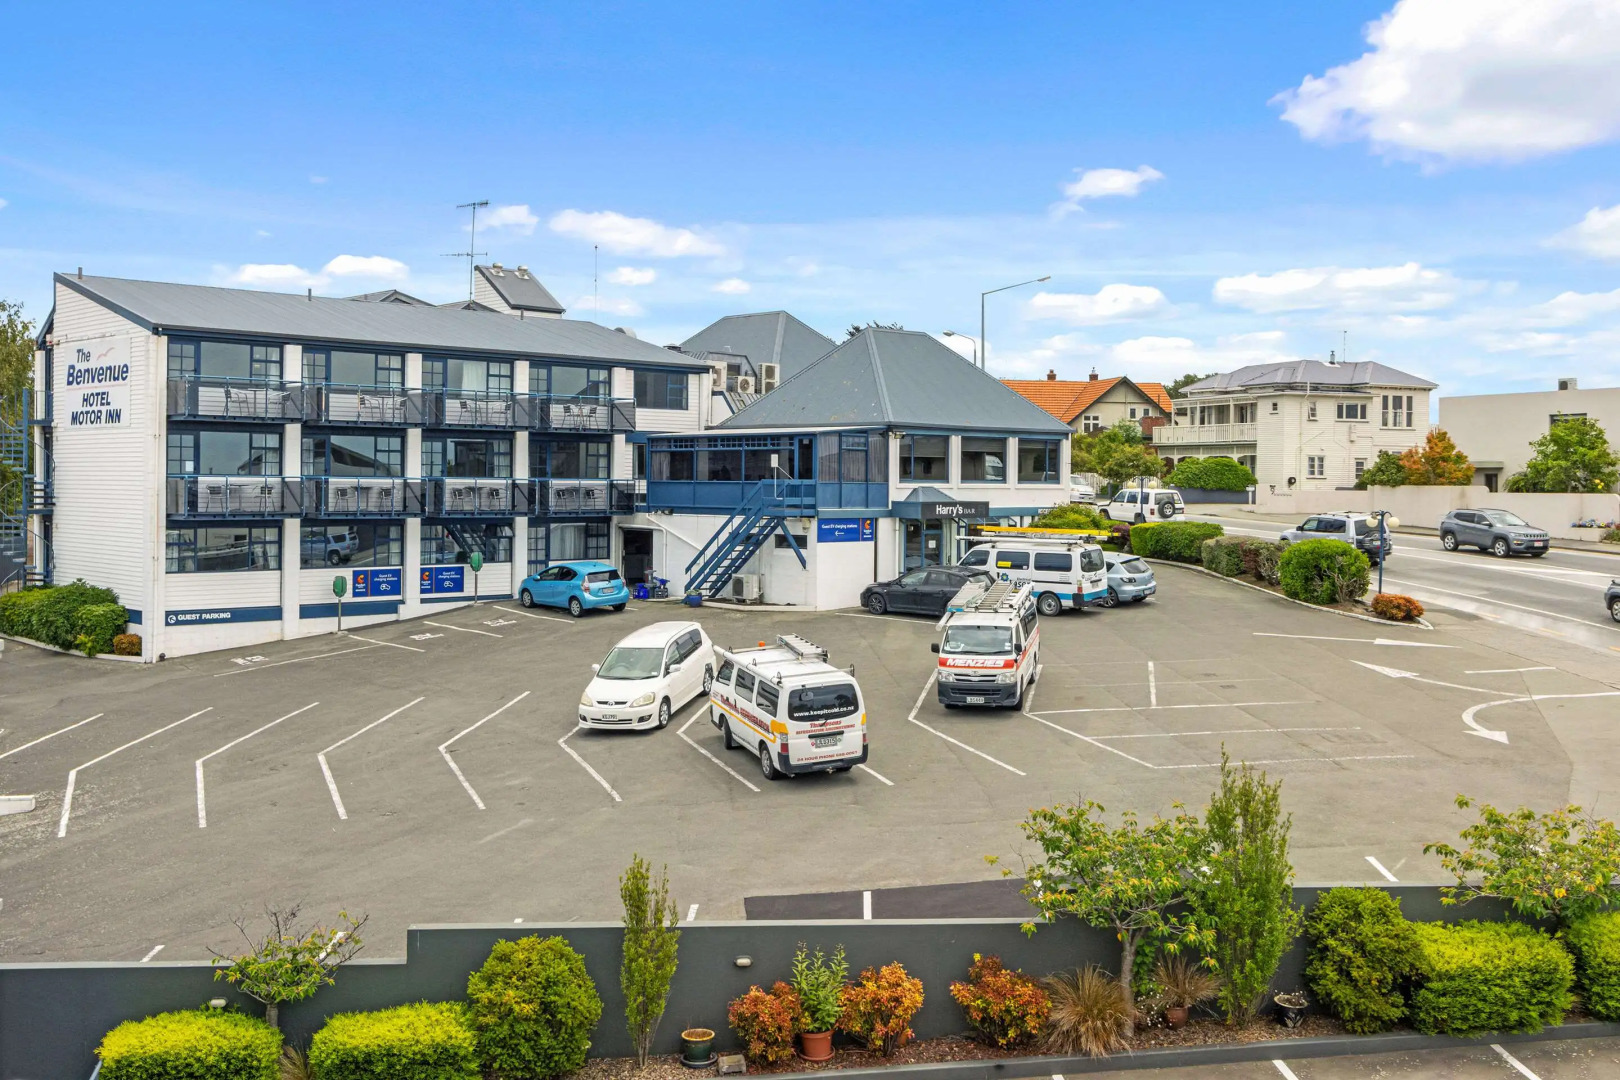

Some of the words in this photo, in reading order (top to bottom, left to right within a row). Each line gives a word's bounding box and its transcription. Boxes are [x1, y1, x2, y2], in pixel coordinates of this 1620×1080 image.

[76, 348, 91, 363] The
[66, 363, 129, 386] Benvenue
[82, 391, 111, 408] HOTEL
[71, 409, 103, 426] MOTOR
[105, 408, 122, 424] INN
[936, 504, 963, 517] Harry's
[947, 659, 1005, 667] MENZIES
